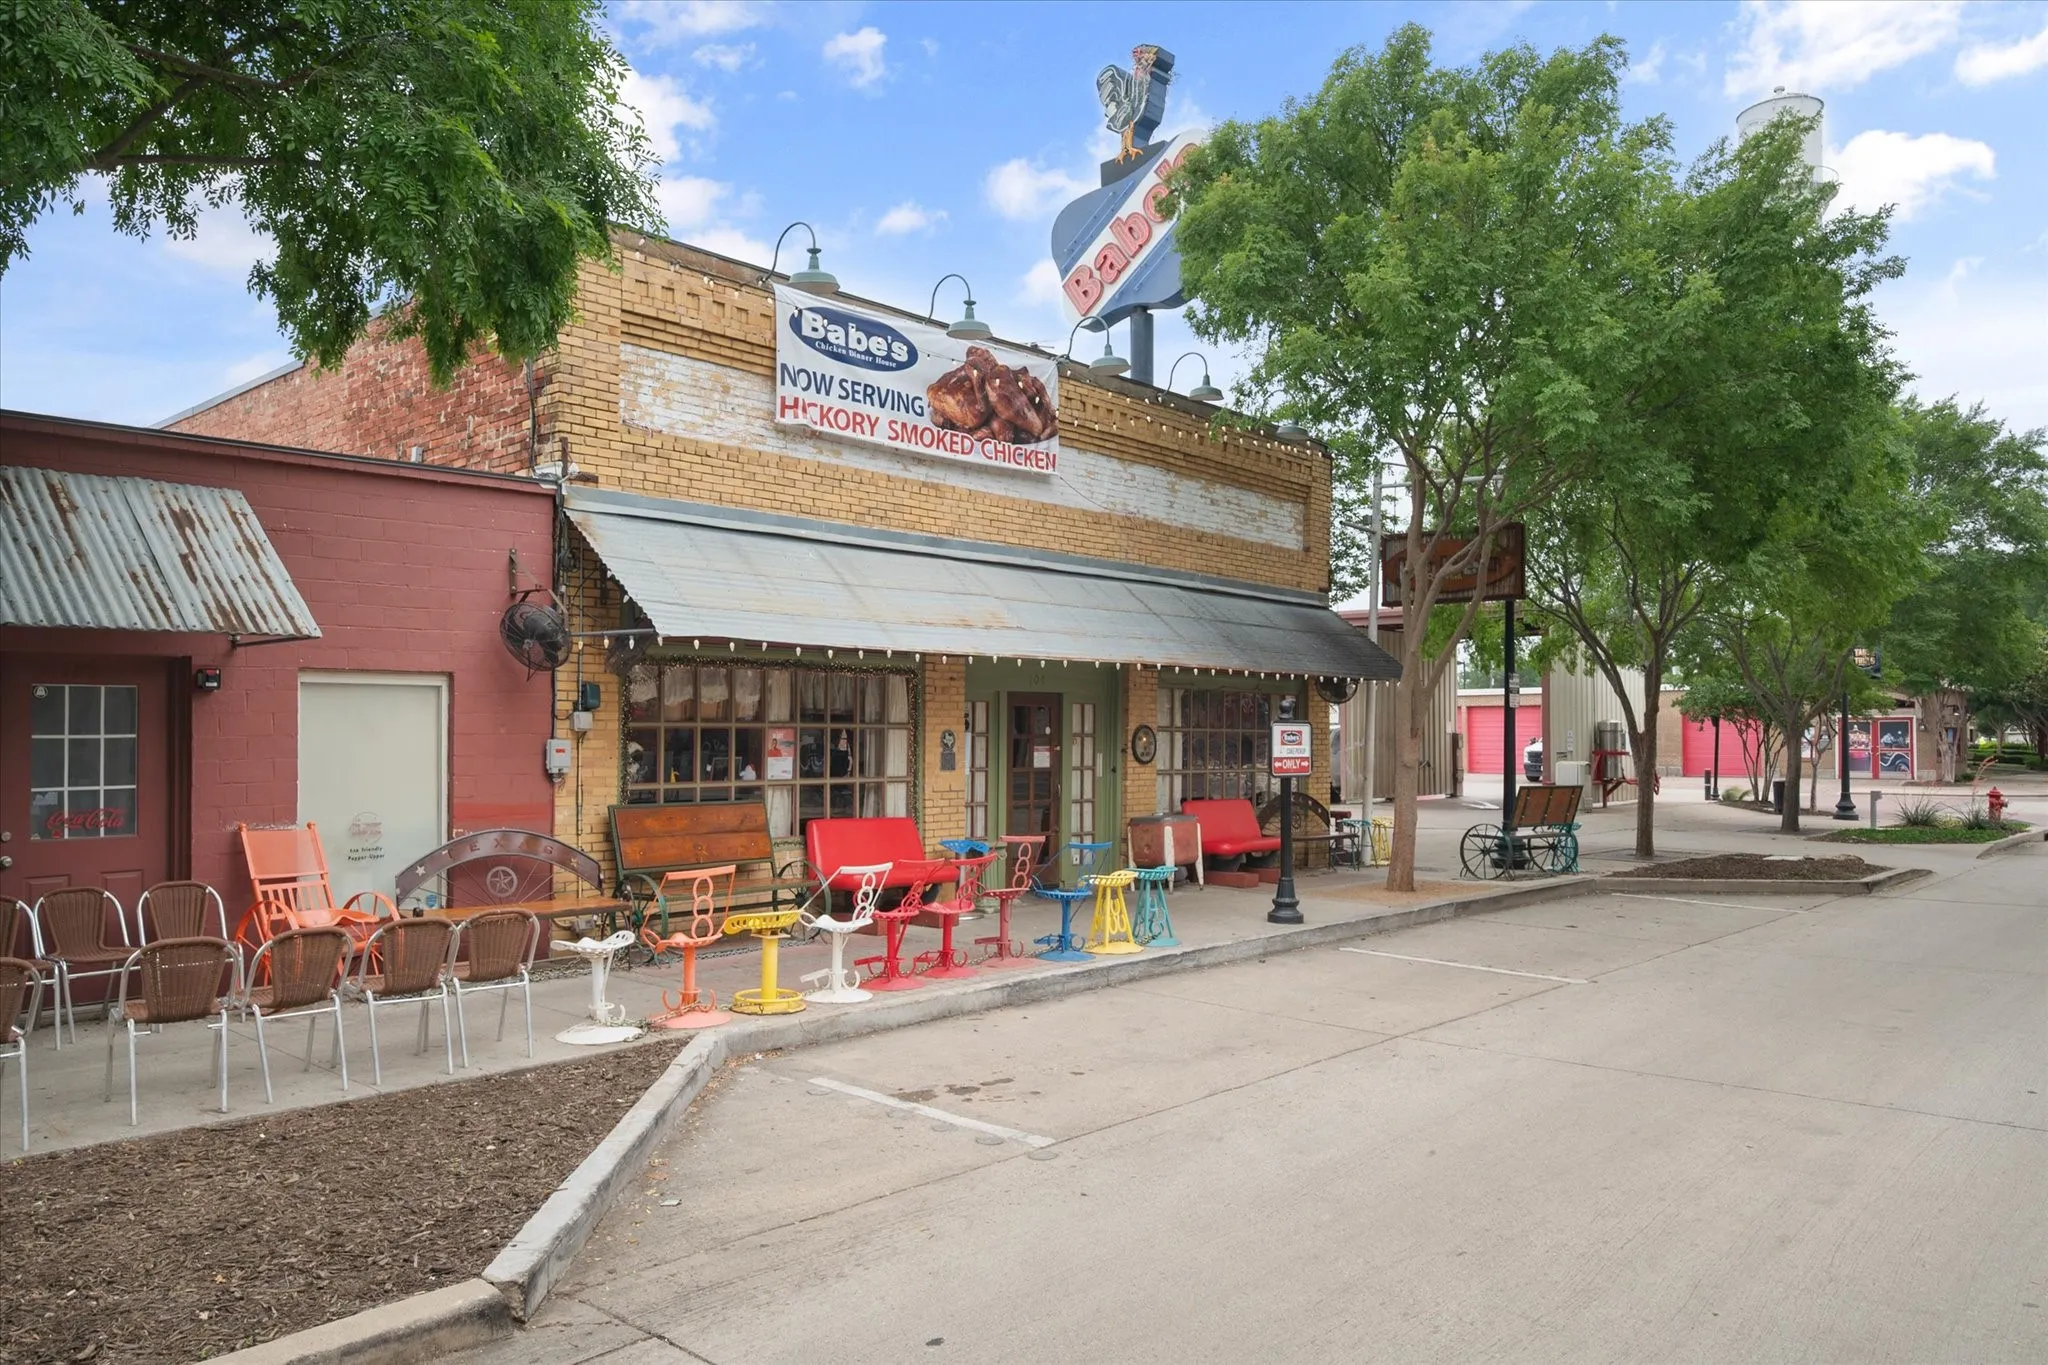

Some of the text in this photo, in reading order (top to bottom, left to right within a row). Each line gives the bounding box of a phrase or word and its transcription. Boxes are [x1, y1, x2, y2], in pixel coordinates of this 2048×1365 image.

[801, 308, 909, 362] Babe's
[815, 340, 897, 369] Chicken Dinner House
[780, 362, 925, 417] NOW SERVING
[780, 395, 1057, 472] HICKORY SMOKED CHICKEN
[1282, 759, 1301, 769] ONLY
[46, 806, 127, 831] Coca-Cola
